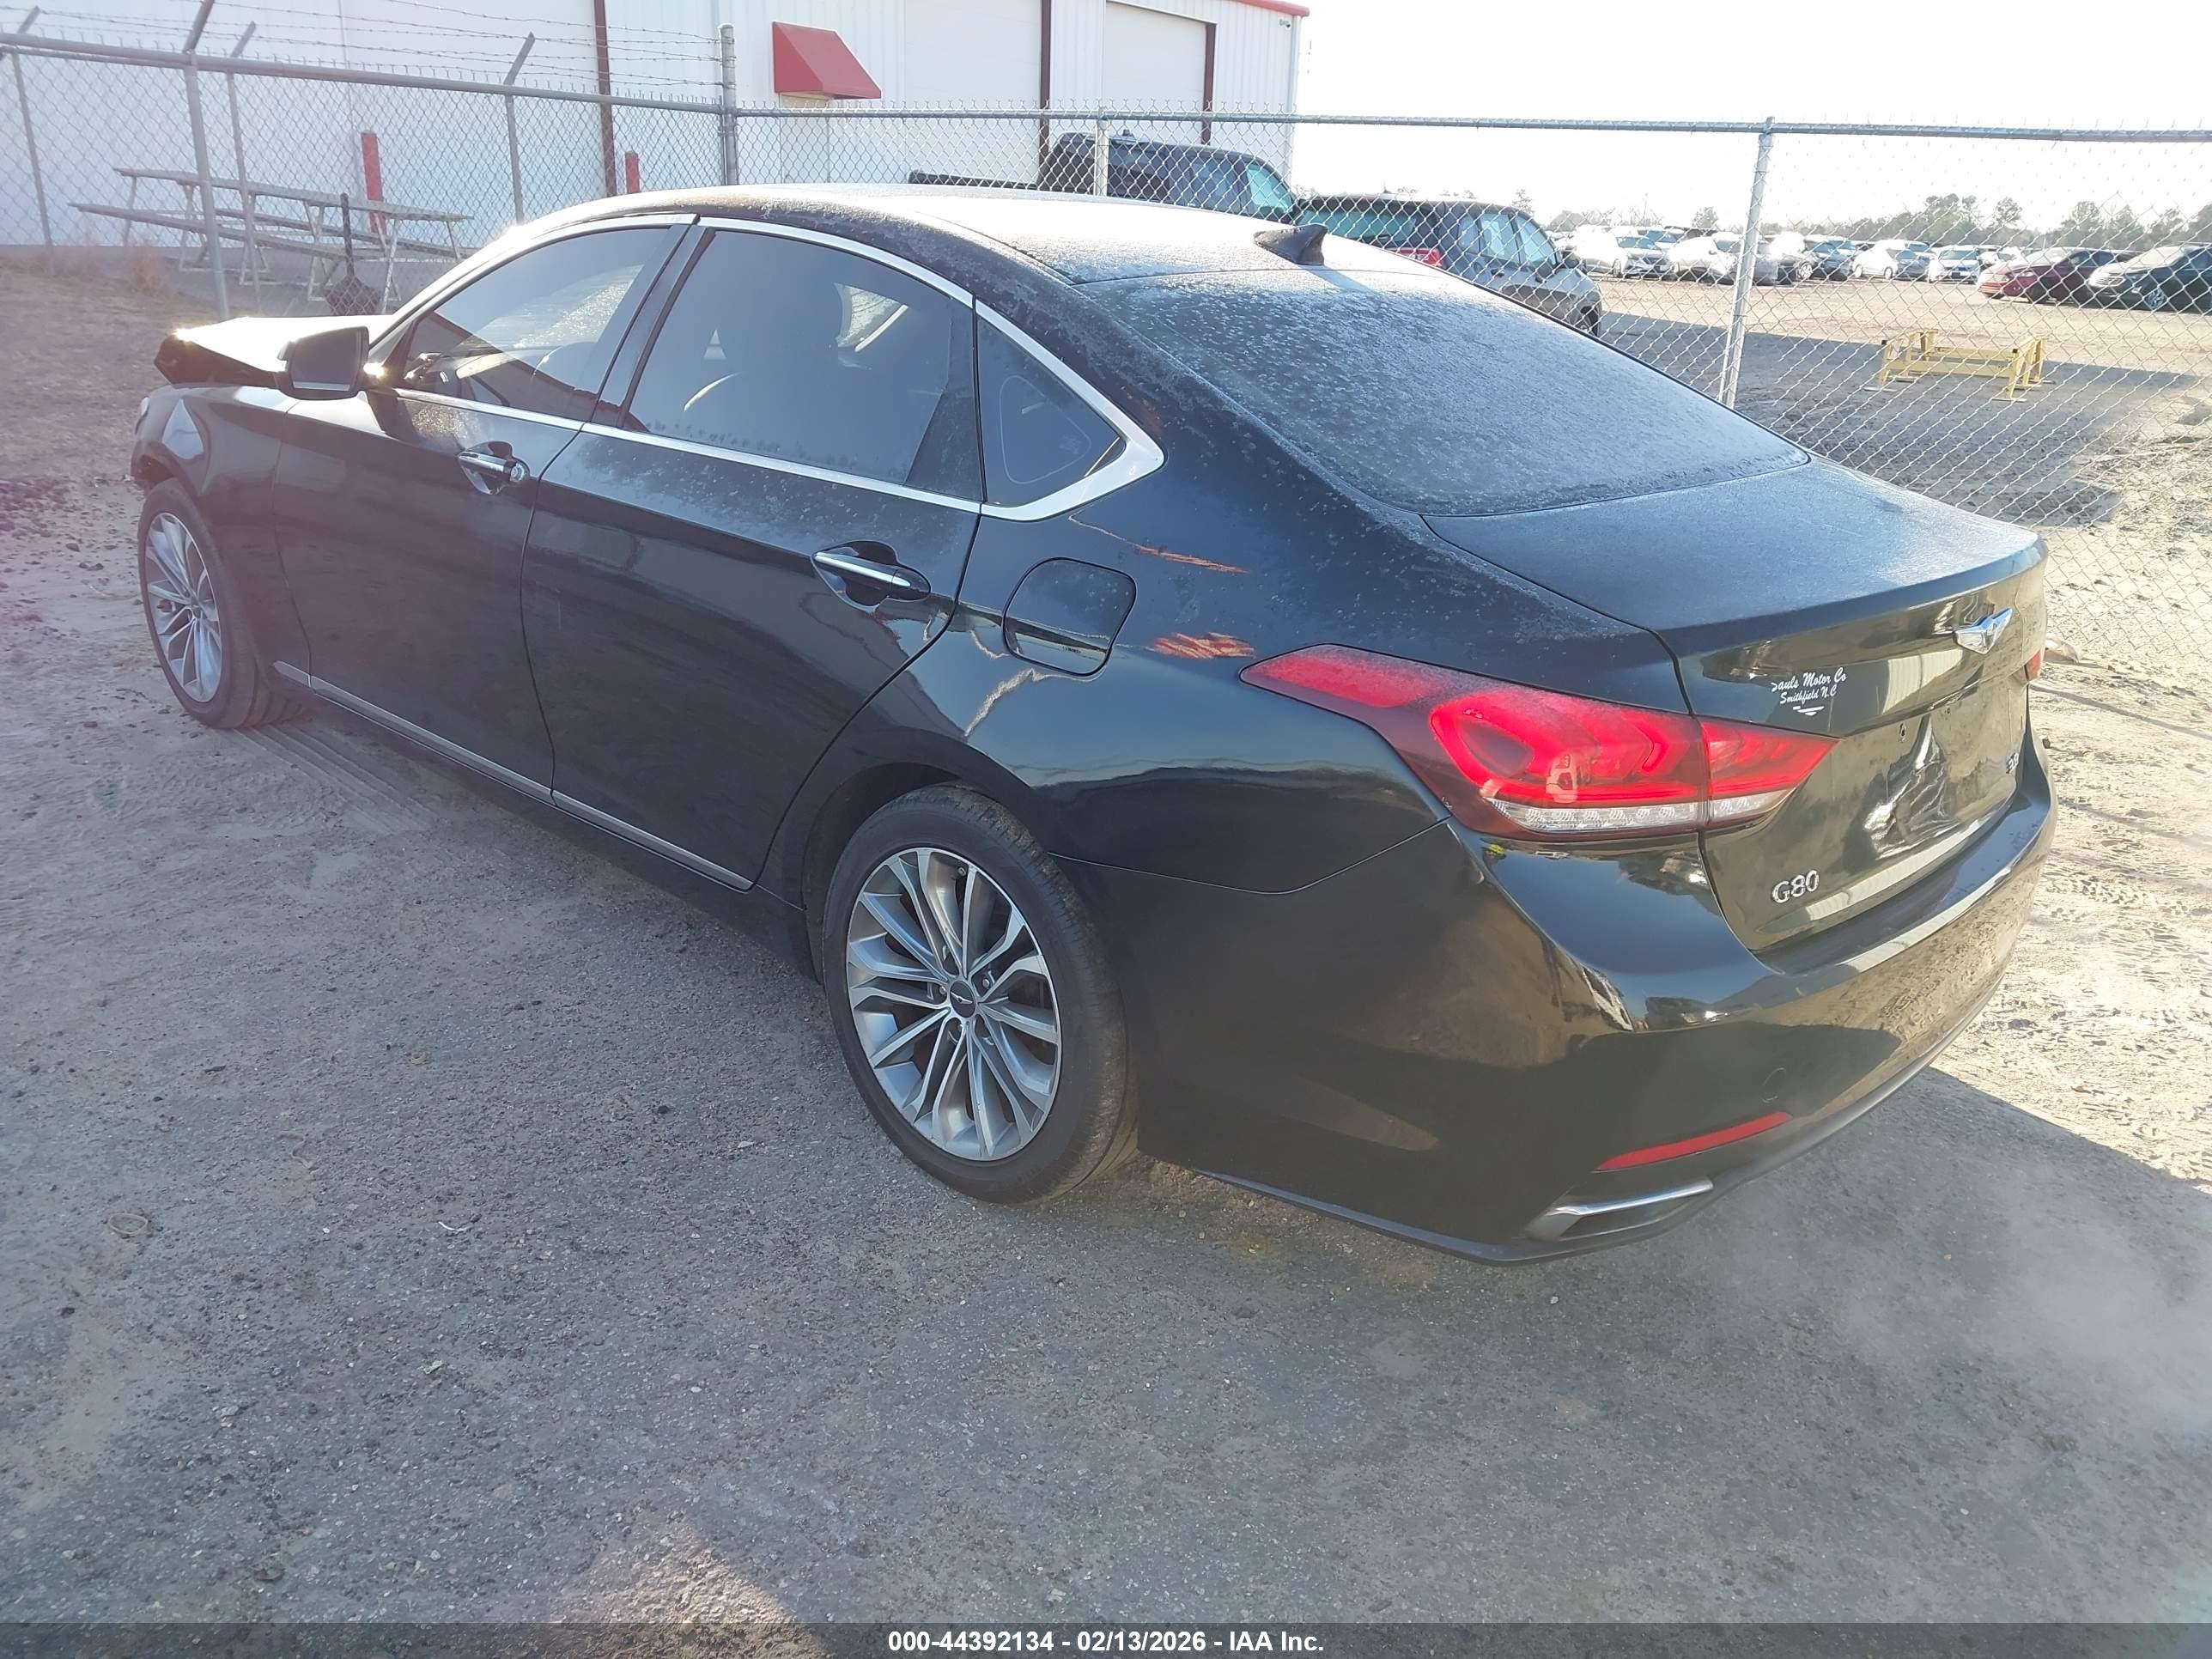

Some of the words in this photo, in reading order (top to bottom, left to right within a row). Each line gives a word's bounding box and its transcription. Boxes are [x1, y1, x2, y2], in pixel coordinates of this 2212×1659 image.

[1802, 672, 1832, 688] Motor
[1833, 666, 1847, 684] Co
[1779, 688, 1820, 705] Smithfield
[1771, 869, 1820, 903] G80
